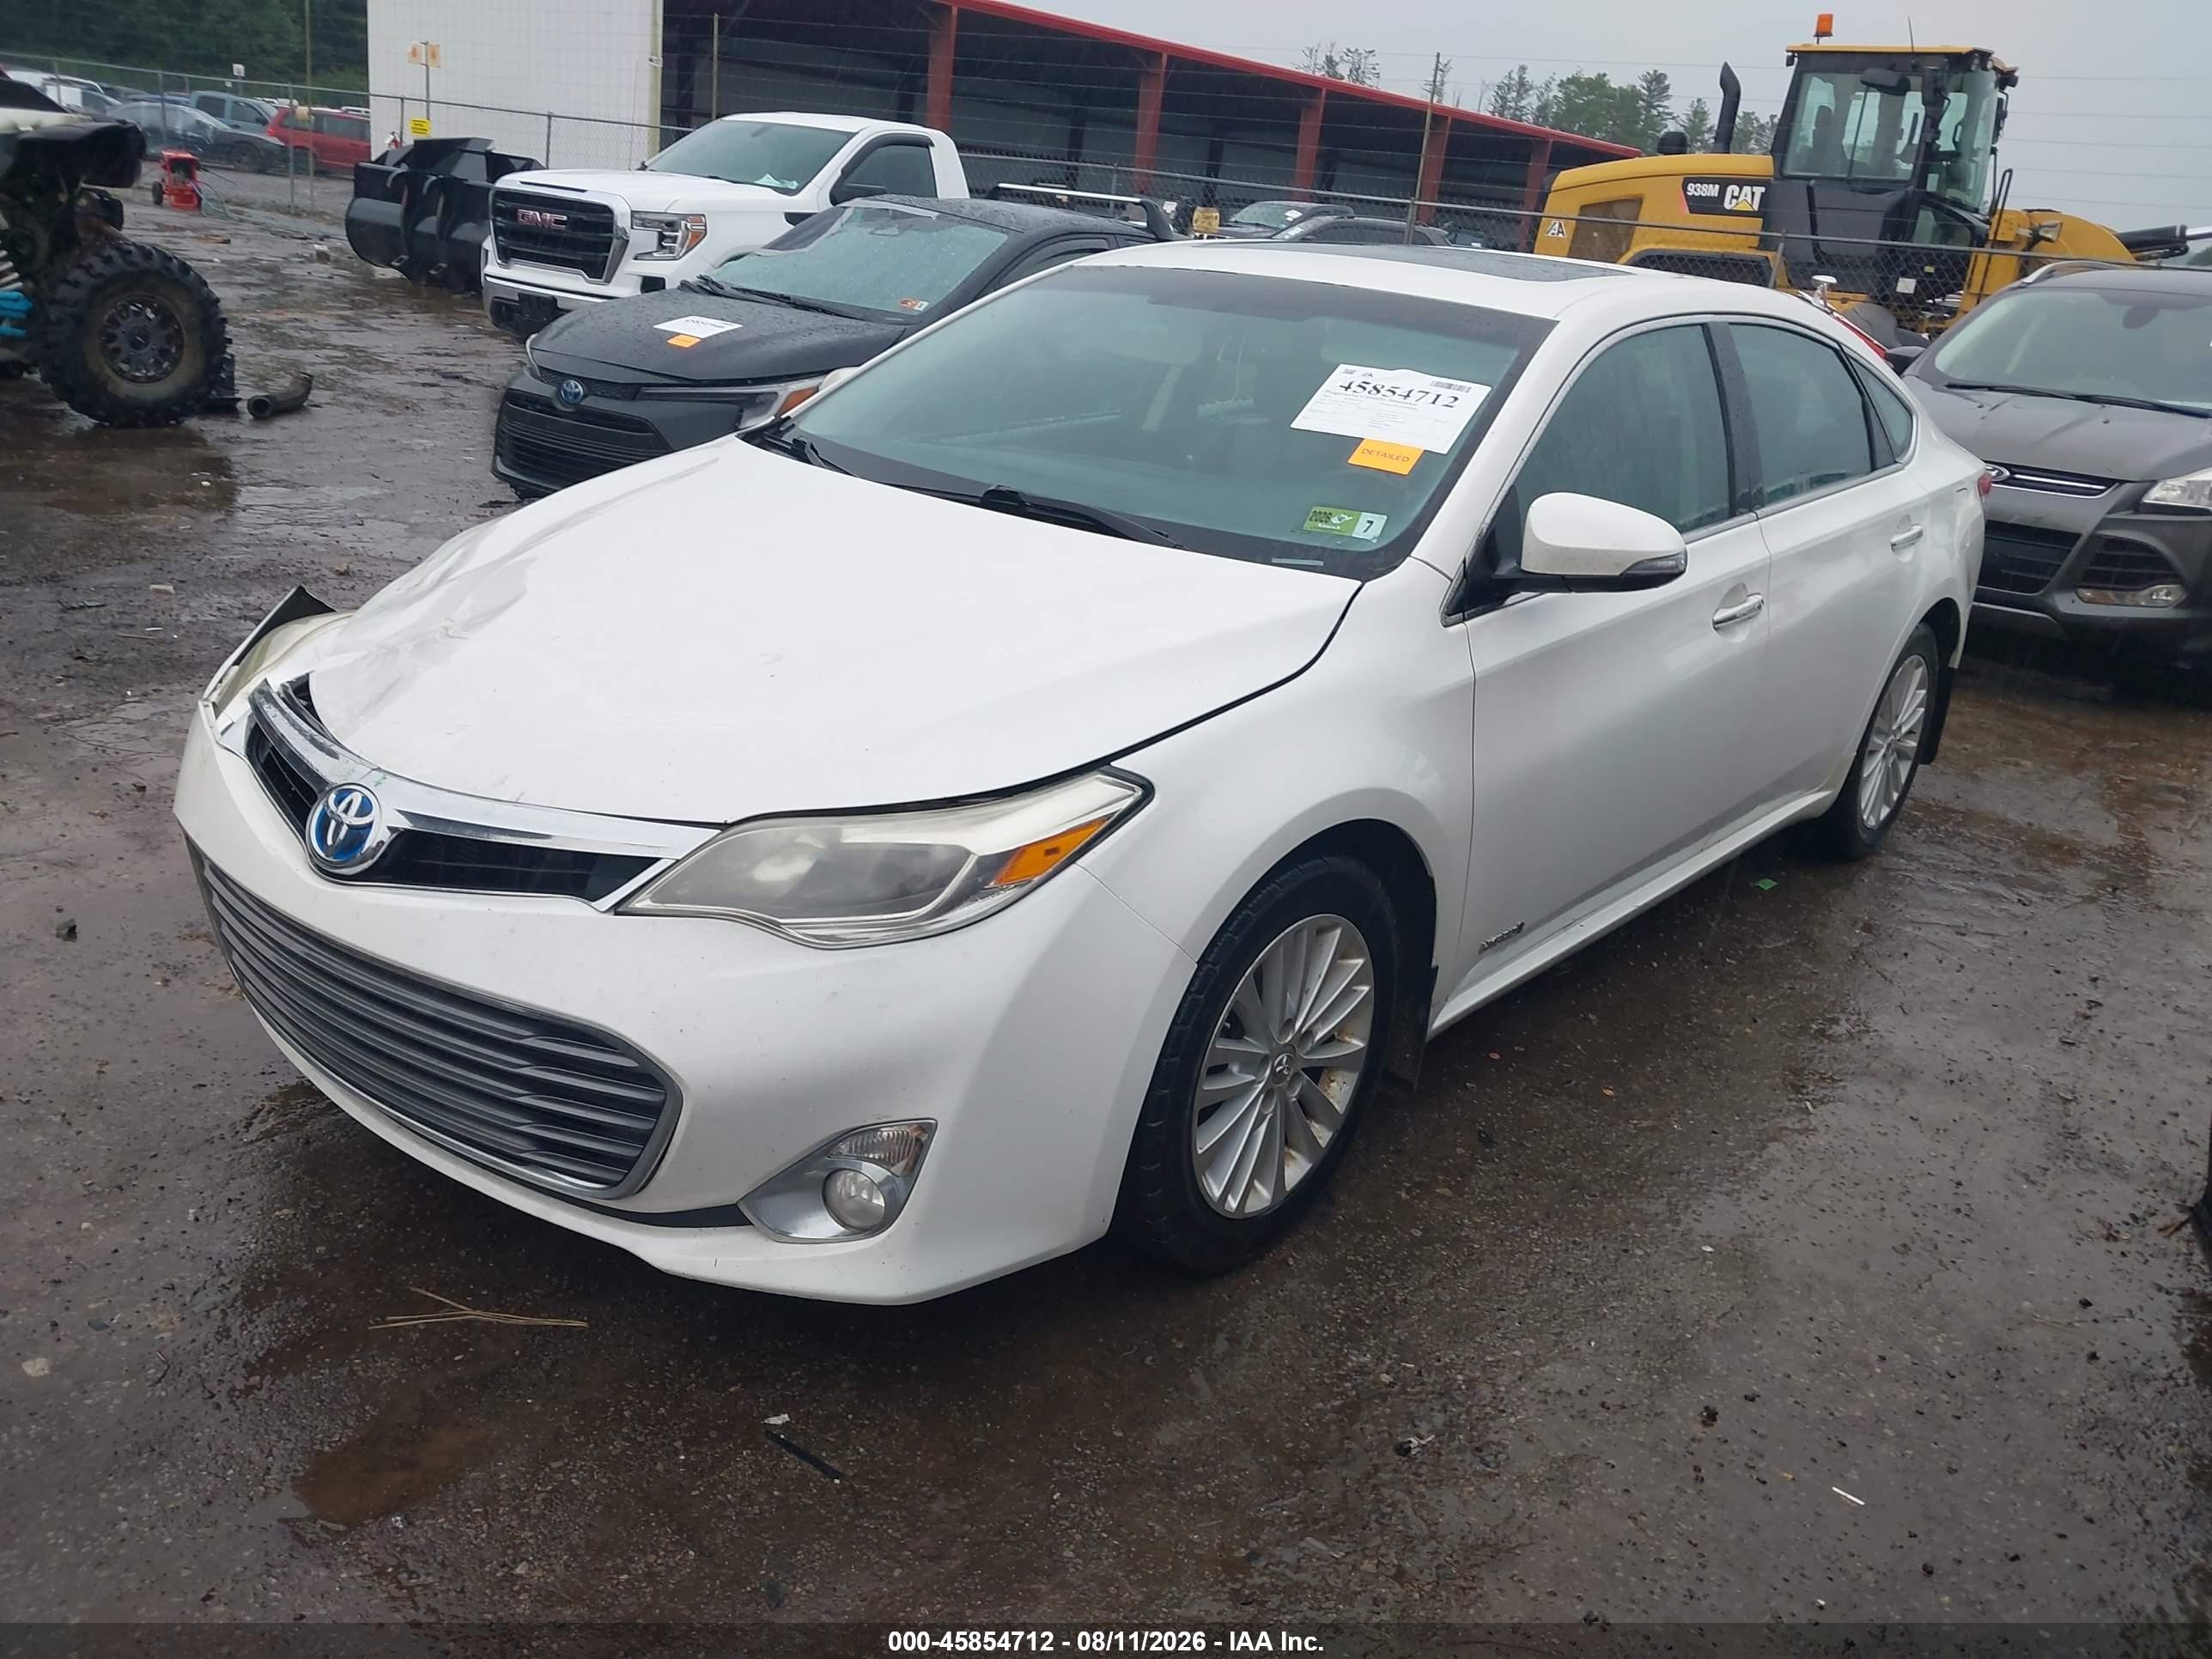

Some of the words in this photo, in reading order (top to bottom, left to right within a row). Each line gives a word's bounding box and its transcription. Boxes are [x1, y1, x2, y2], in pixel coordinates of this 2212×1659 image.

[1686, 183, 1720, 198] 938M
[1723, 185, 1765, 211] CAT
[517, 209, 568, 229] GMC
[1339, 380, 1460, 409] 45854712
[1361, 447, 1410, 462] DETAILED
[1364, 520, 1375, 533] 7
